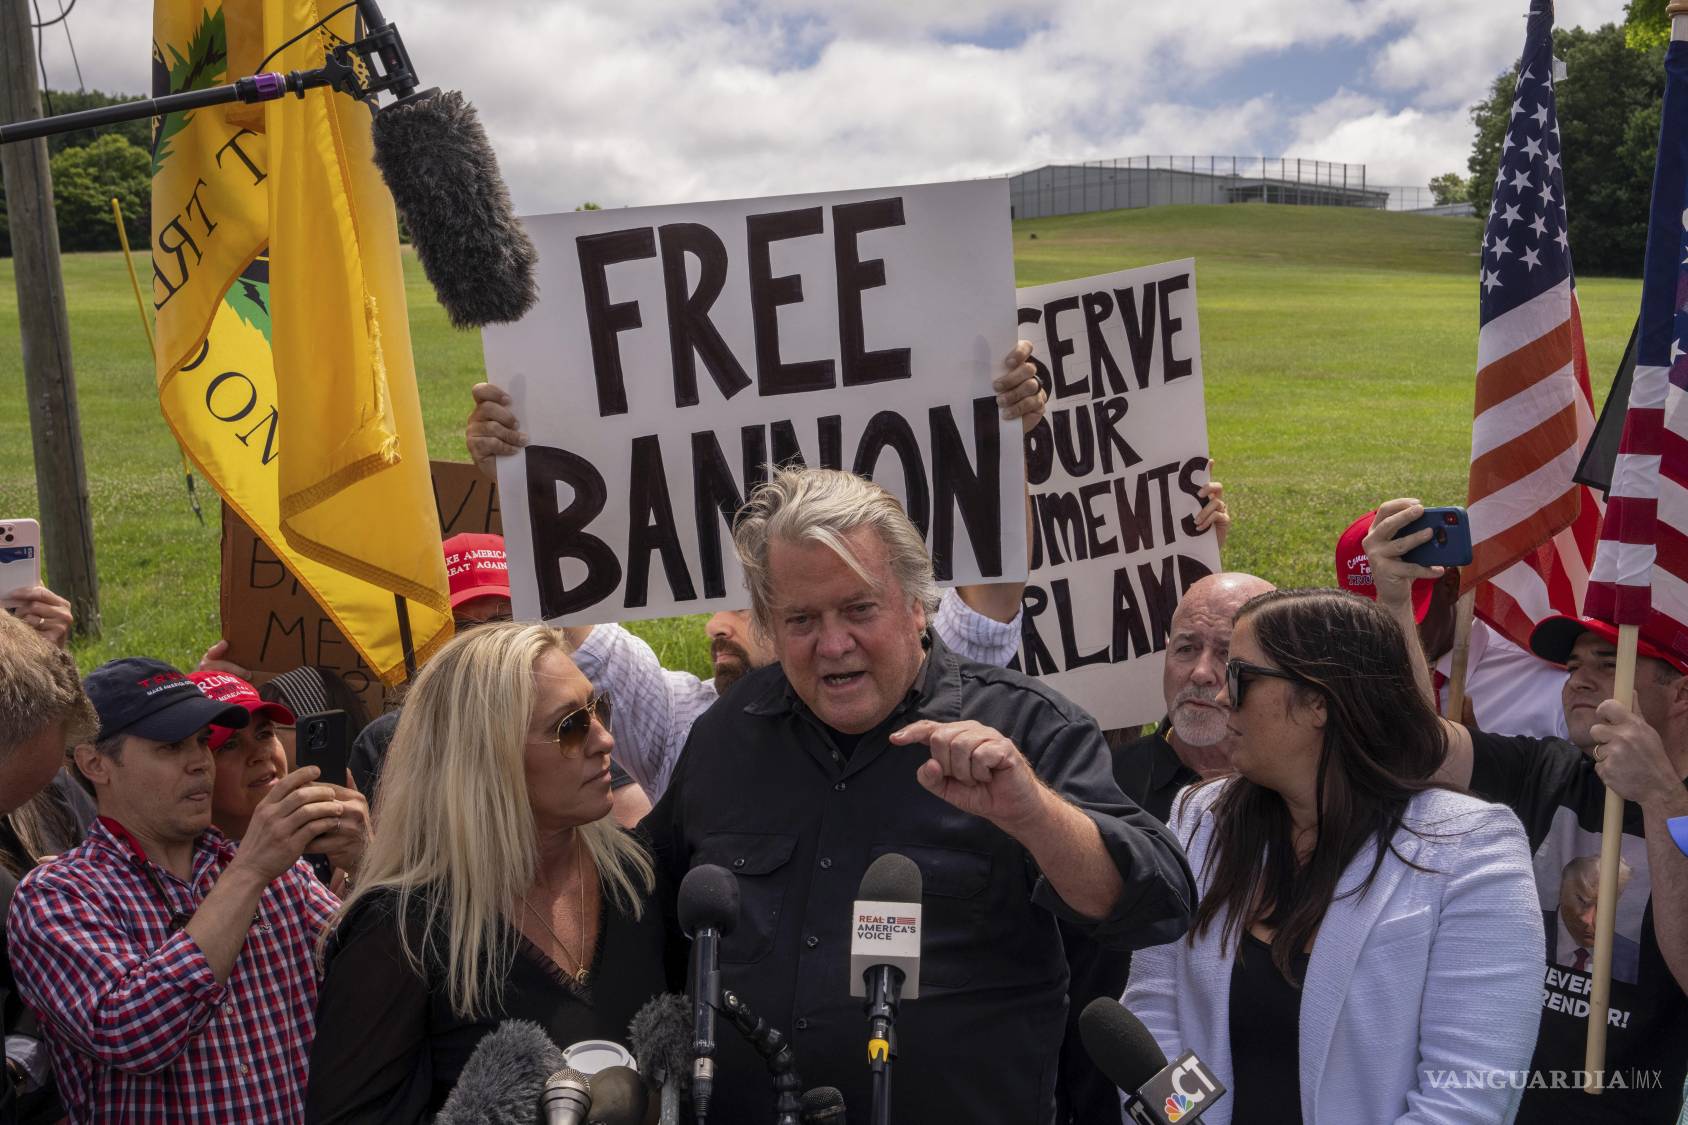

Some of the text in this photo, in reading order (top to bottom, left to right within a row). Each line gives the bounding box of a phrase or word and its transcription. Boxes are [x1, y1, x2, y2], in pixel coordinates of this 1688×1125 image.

[576, 197, 912, 417] FREE
[477, 560, 507, 570] AGAIN
[859, 915, 885, 924] REAL
[857, 924, 916, 934] AMERICA'S
[857, 932, 892, 941] VOICE
[1171, 1055, 1217, 1103] CT
